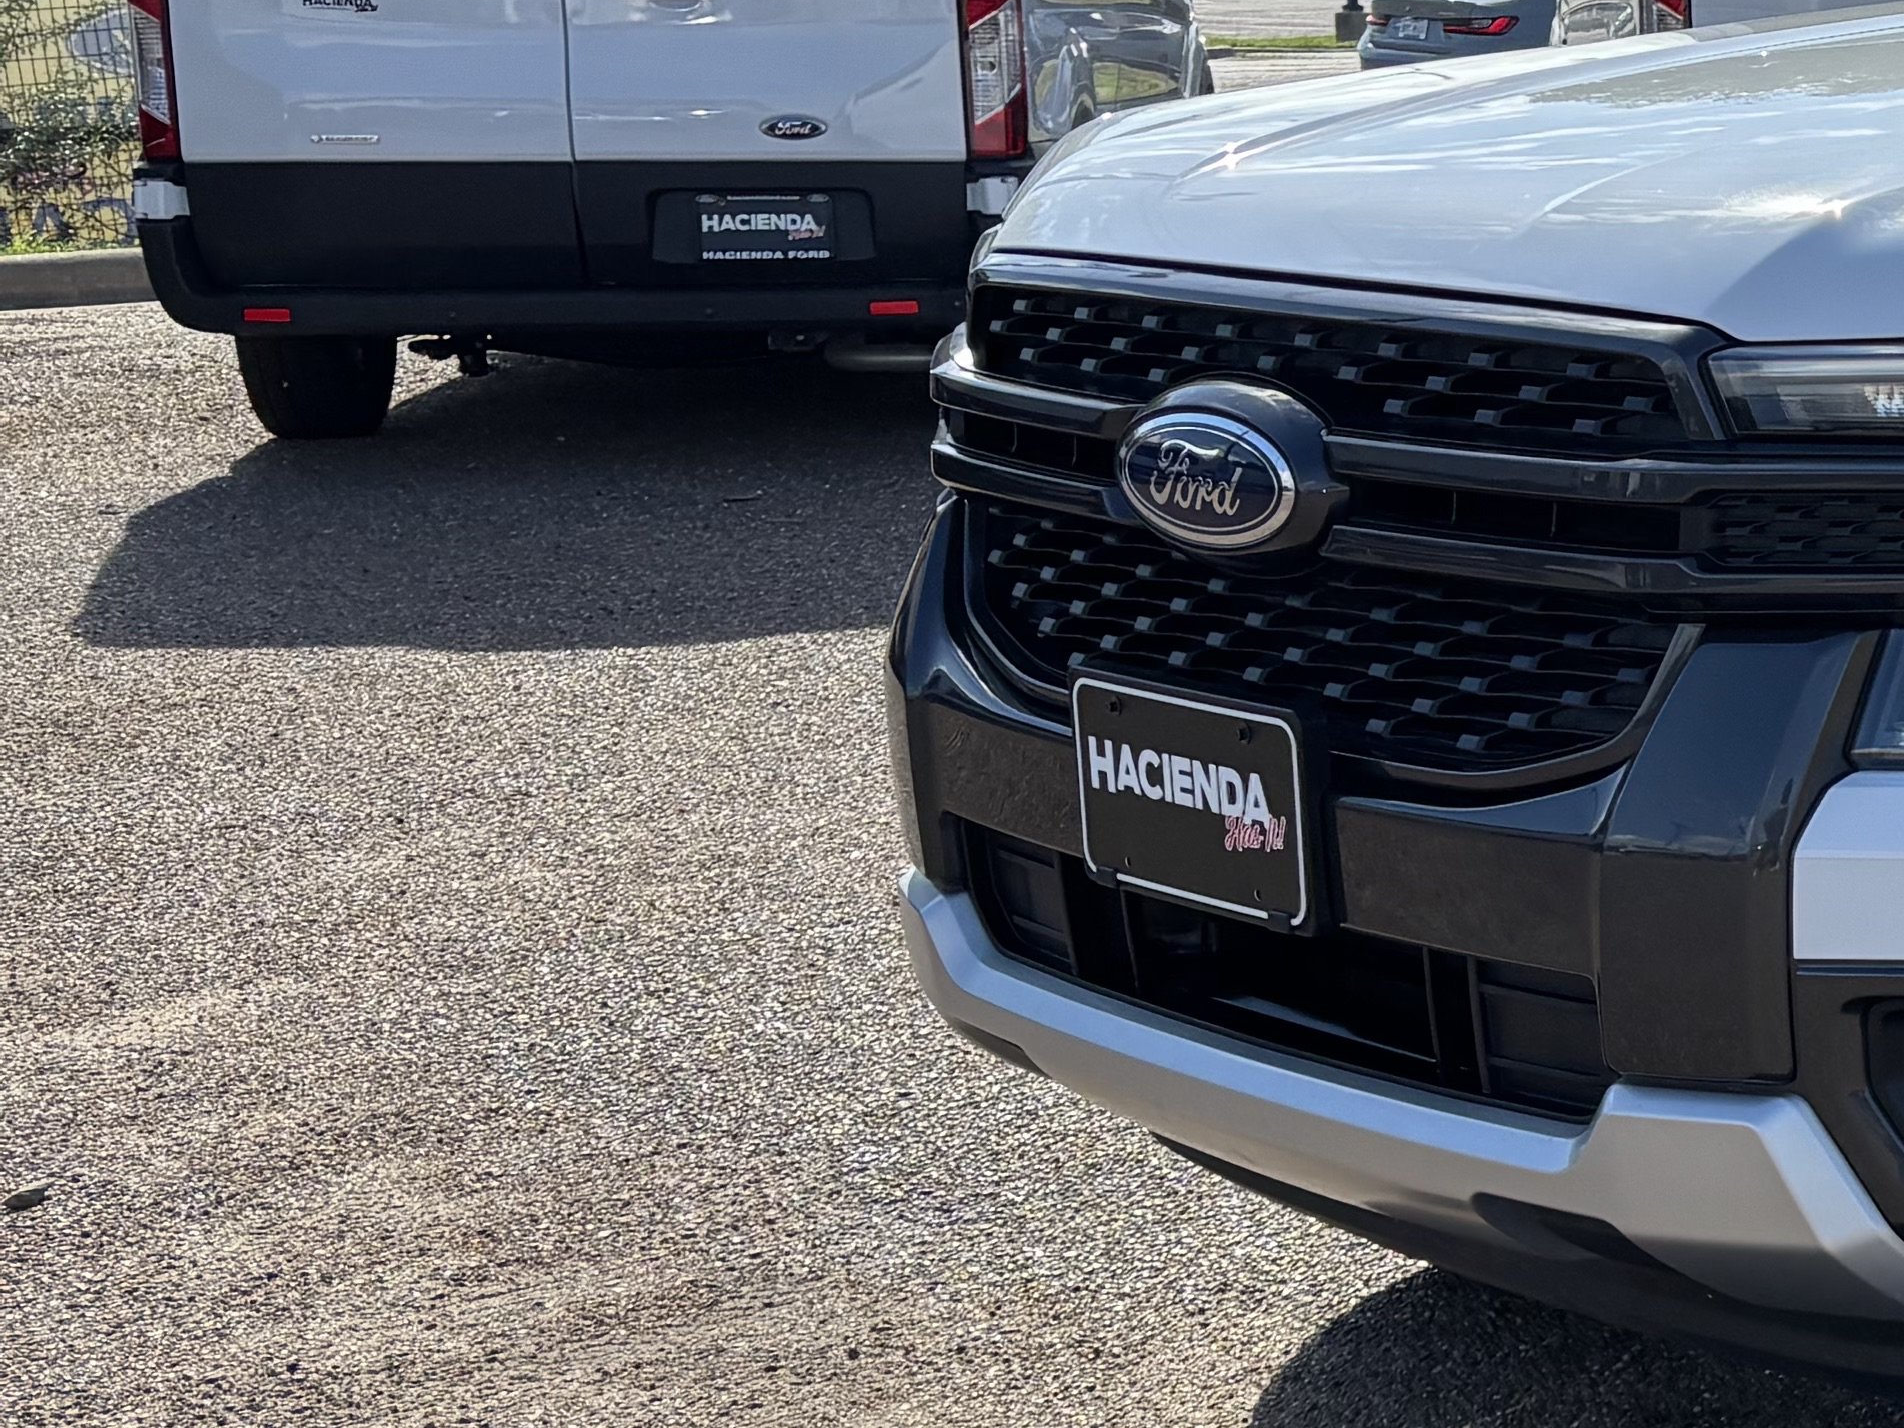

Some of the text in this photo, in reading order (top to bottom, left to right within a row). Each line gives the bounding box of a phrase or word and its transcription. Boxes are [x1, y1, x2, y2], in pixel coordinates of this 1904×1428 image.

[774, 121, 812, 135] Ford
[701, 214, 818, 232] HACIENDA
[702, 250, 830, 260] HACIENDA FORD
[1150, 438, 1243, 517] Ford
[1087, 735, 1270, 832] HACIENDA
